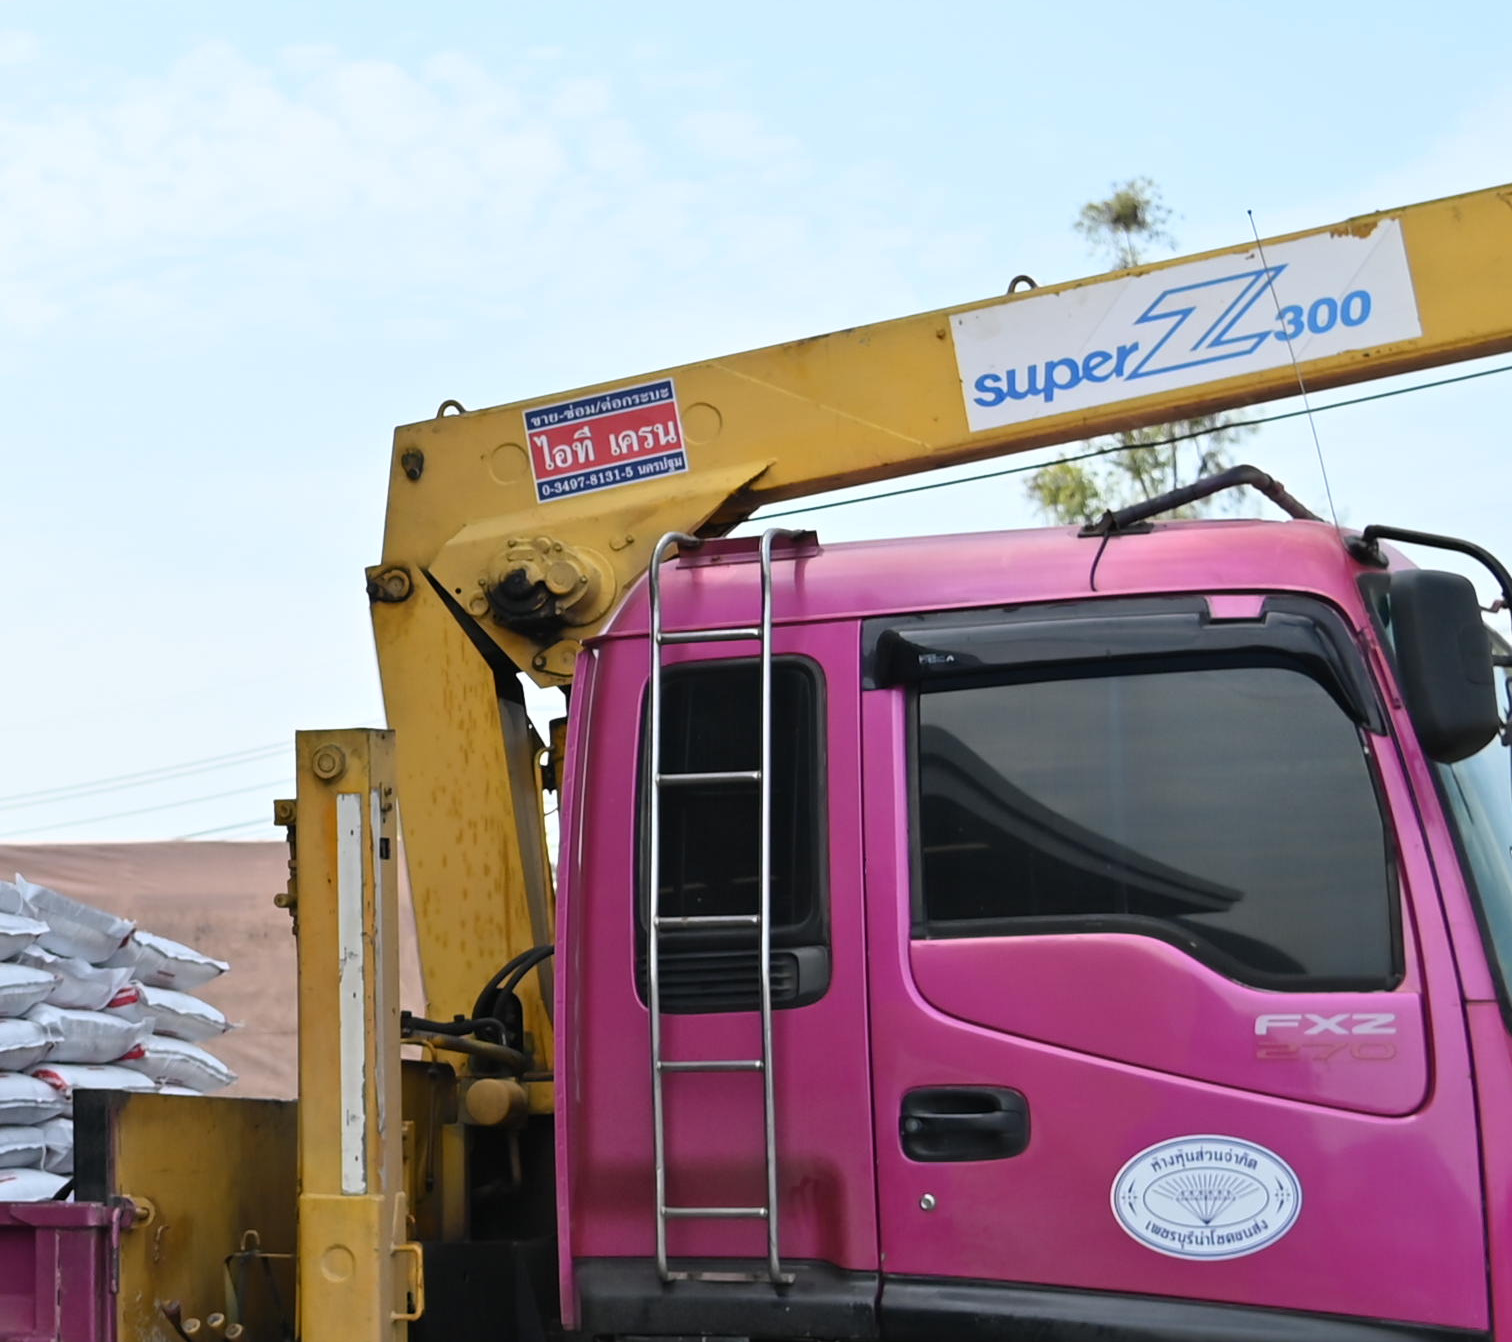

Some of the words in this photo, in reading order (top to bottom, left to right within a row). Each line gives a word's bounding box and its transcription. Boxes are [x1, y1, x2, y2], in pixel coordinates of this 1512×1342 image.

[973, 341, 1139, 408] super
[1272, 289, 1373, 342] 300
[530, 386, 670, 427] ขาย-ซ่อม/ต่อกระบะ
[533, 425, 596, 471] ไอที
[608, 421, 677, 456] เครน
[541, 466, 634, 496] 0-3497-8131-5
[637, 457, 683, 476] นครปฐม
[1254, 1013, 1397, 1036] FXZ
